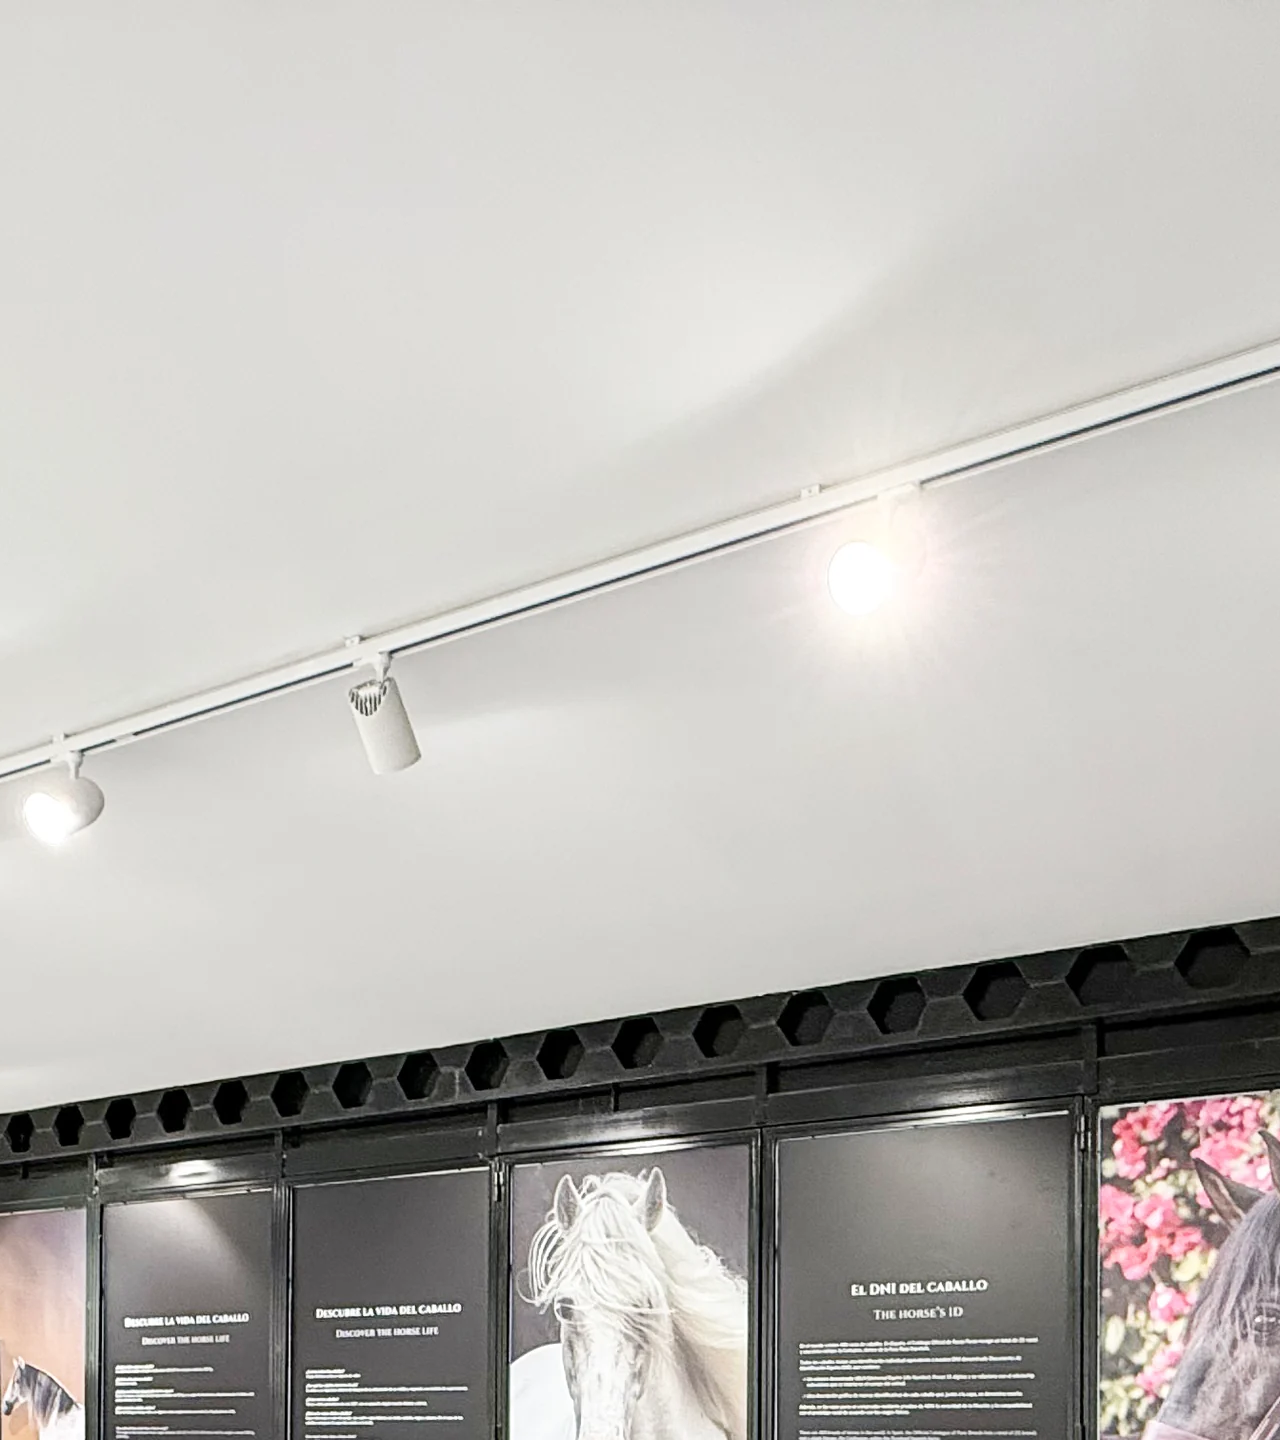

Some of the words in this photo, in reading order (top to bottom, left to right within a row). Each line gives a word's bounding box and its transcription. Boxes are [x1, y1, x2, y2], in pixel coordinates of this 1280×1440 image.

[851, 1284, 867, 1296] EL
[869, 1282, 896, 1296] DNI
[899, 1282, 925, 1294] DEL
[926, 1279, 989, 1293] CABALLO
[362, 1307, 374, 1317] LA
[375, 1306, 399, 1316] VIDA
[399, 1305, 418, 1315] DEL
[418, 1303, 462, 1314] CABALLO
[873, 1309, 896, 1320] THE
[948, 1306, 964, 1318] ID
